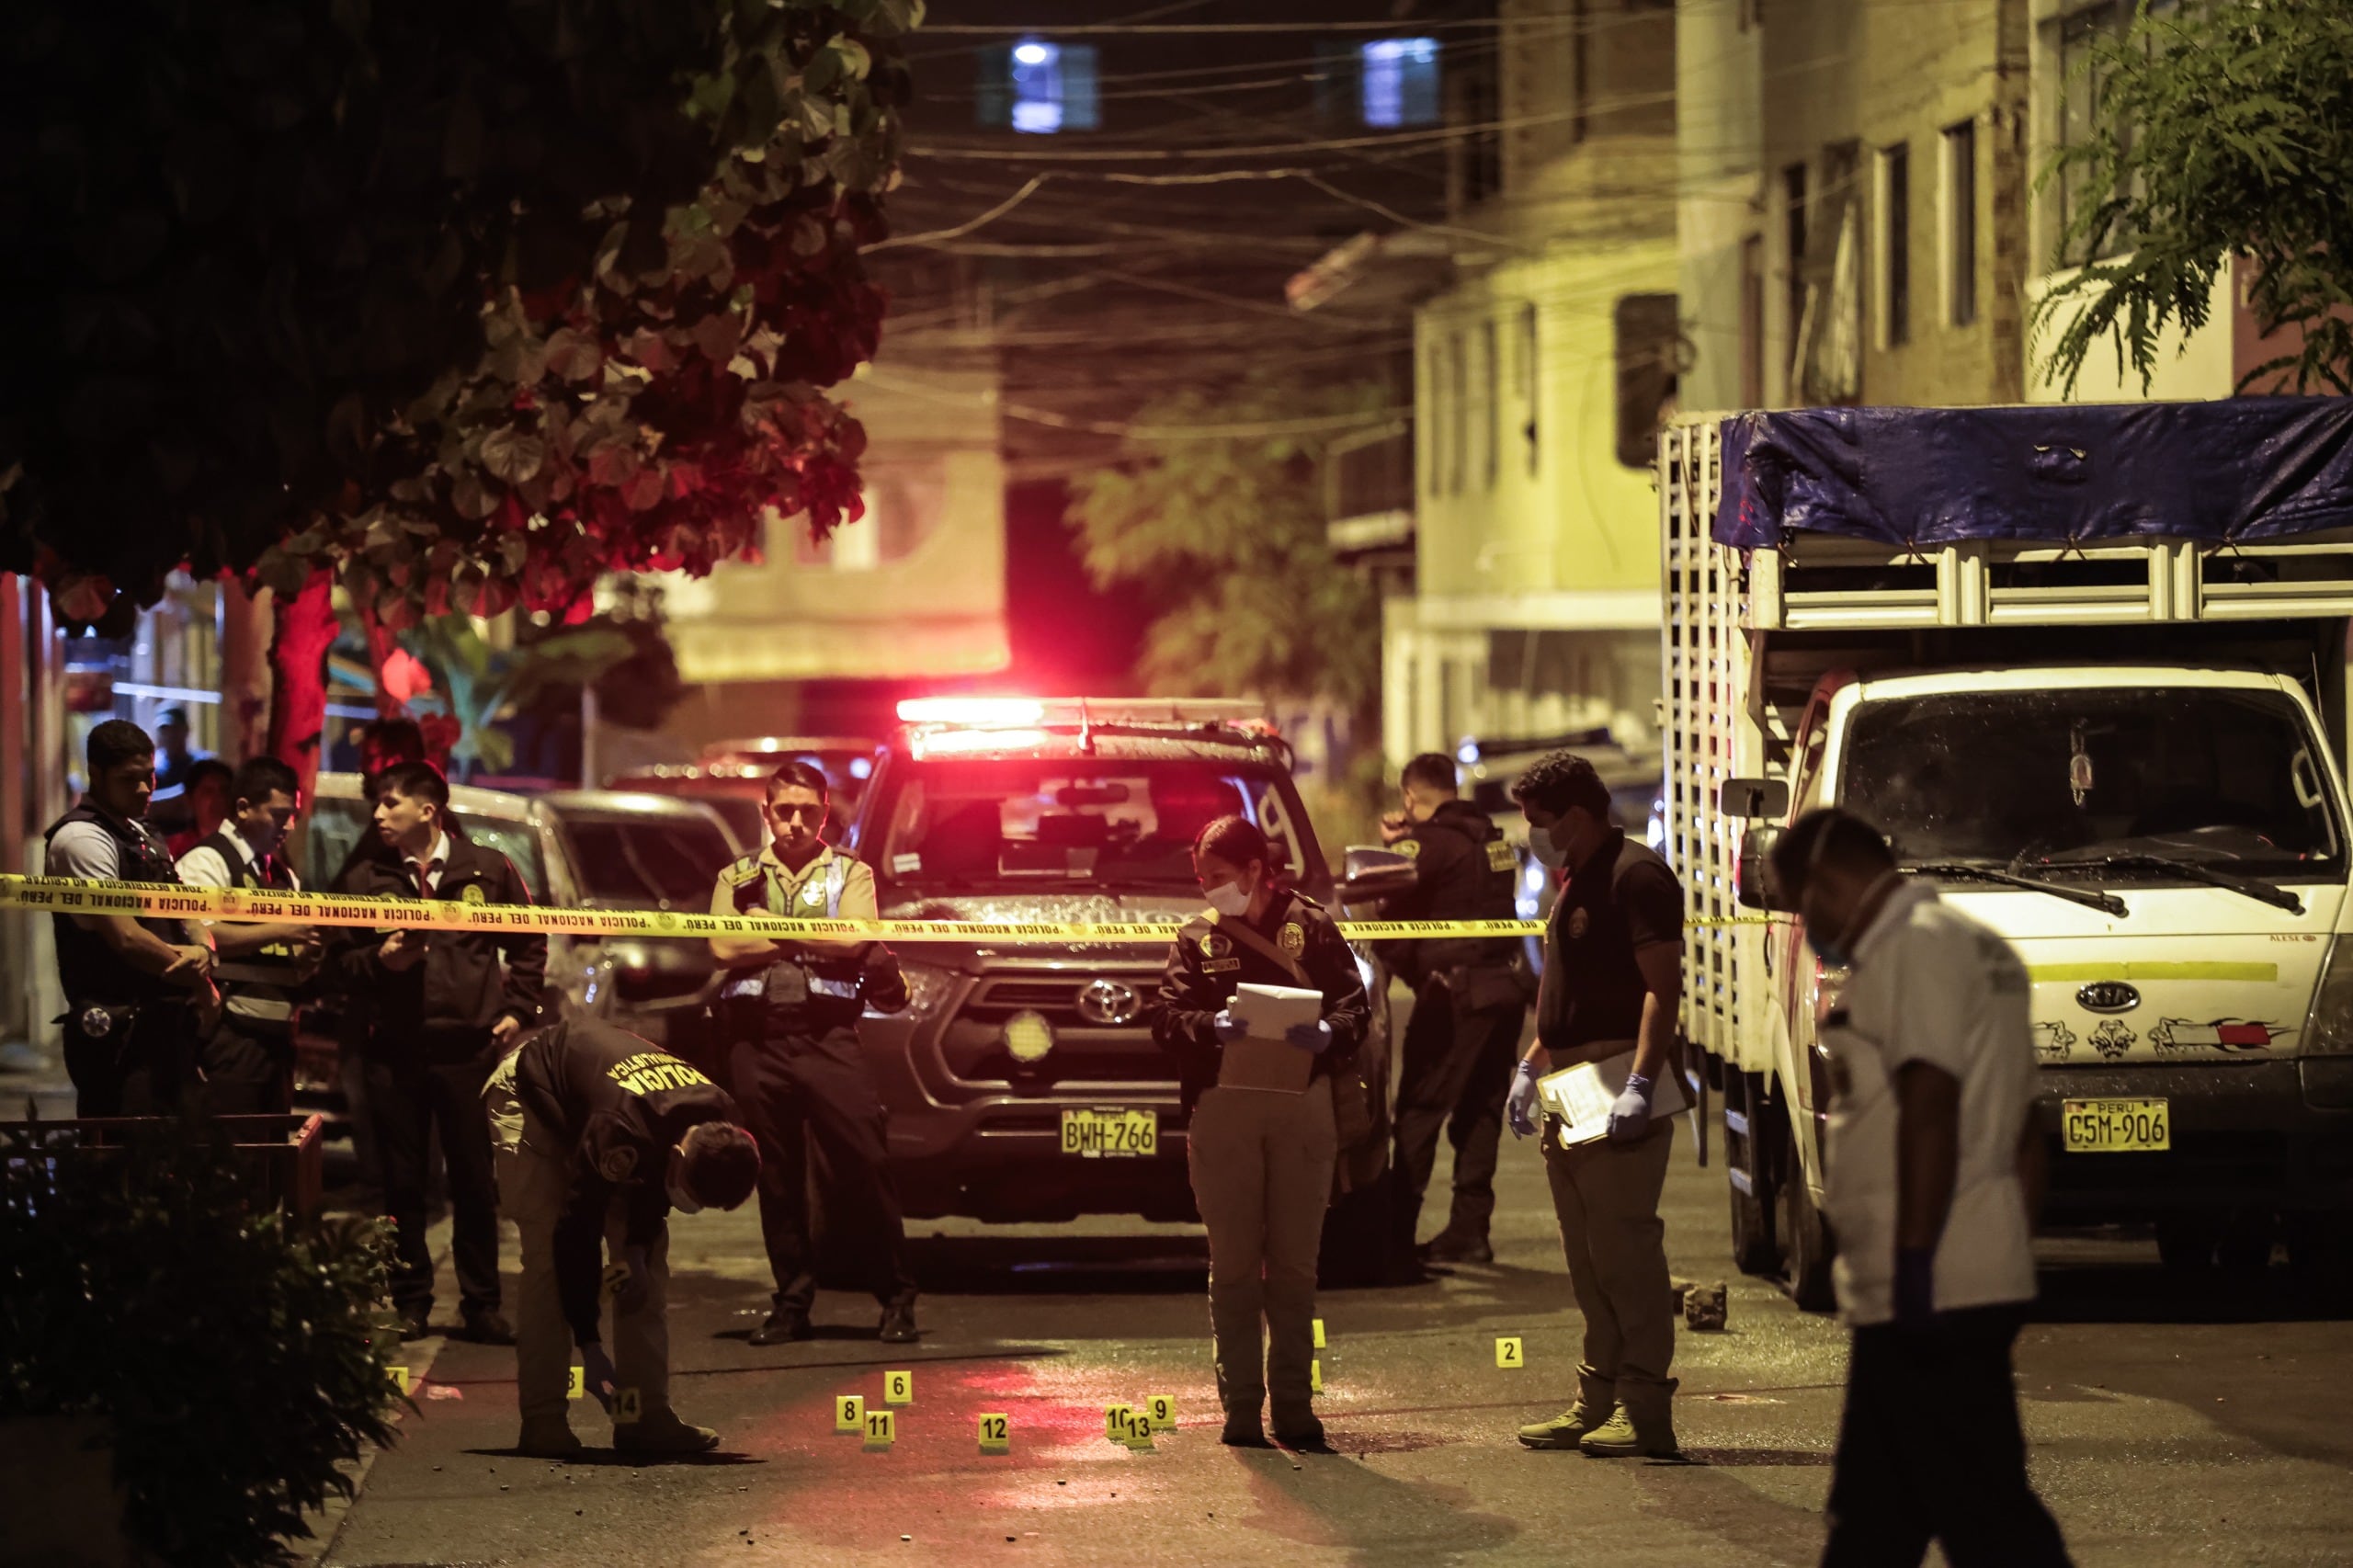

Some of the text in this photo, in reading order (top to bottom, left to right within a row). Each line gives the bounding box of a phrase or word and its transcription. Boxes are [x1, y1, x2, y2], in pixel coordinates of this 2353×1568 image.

[2097, 1103, 2134, 1113] PERU
[1066, 1122, 1154, 1149] BWH-766
[2069, 1114, 2165, 1143] C5M-906
[1504, 1342, 1516, 1360] 2
[892, 1376, 904, 1395] 6
[614, 1392, 637, 1415] 14
[844, 1401, 856, 1421] 8
[1154, 1399, 1166, 1420] 9
[869, 1415, 888, 1436] 11
[983, 1418, 1007, 1439] 12
[1127, 1416, 1151, 1438] 13
